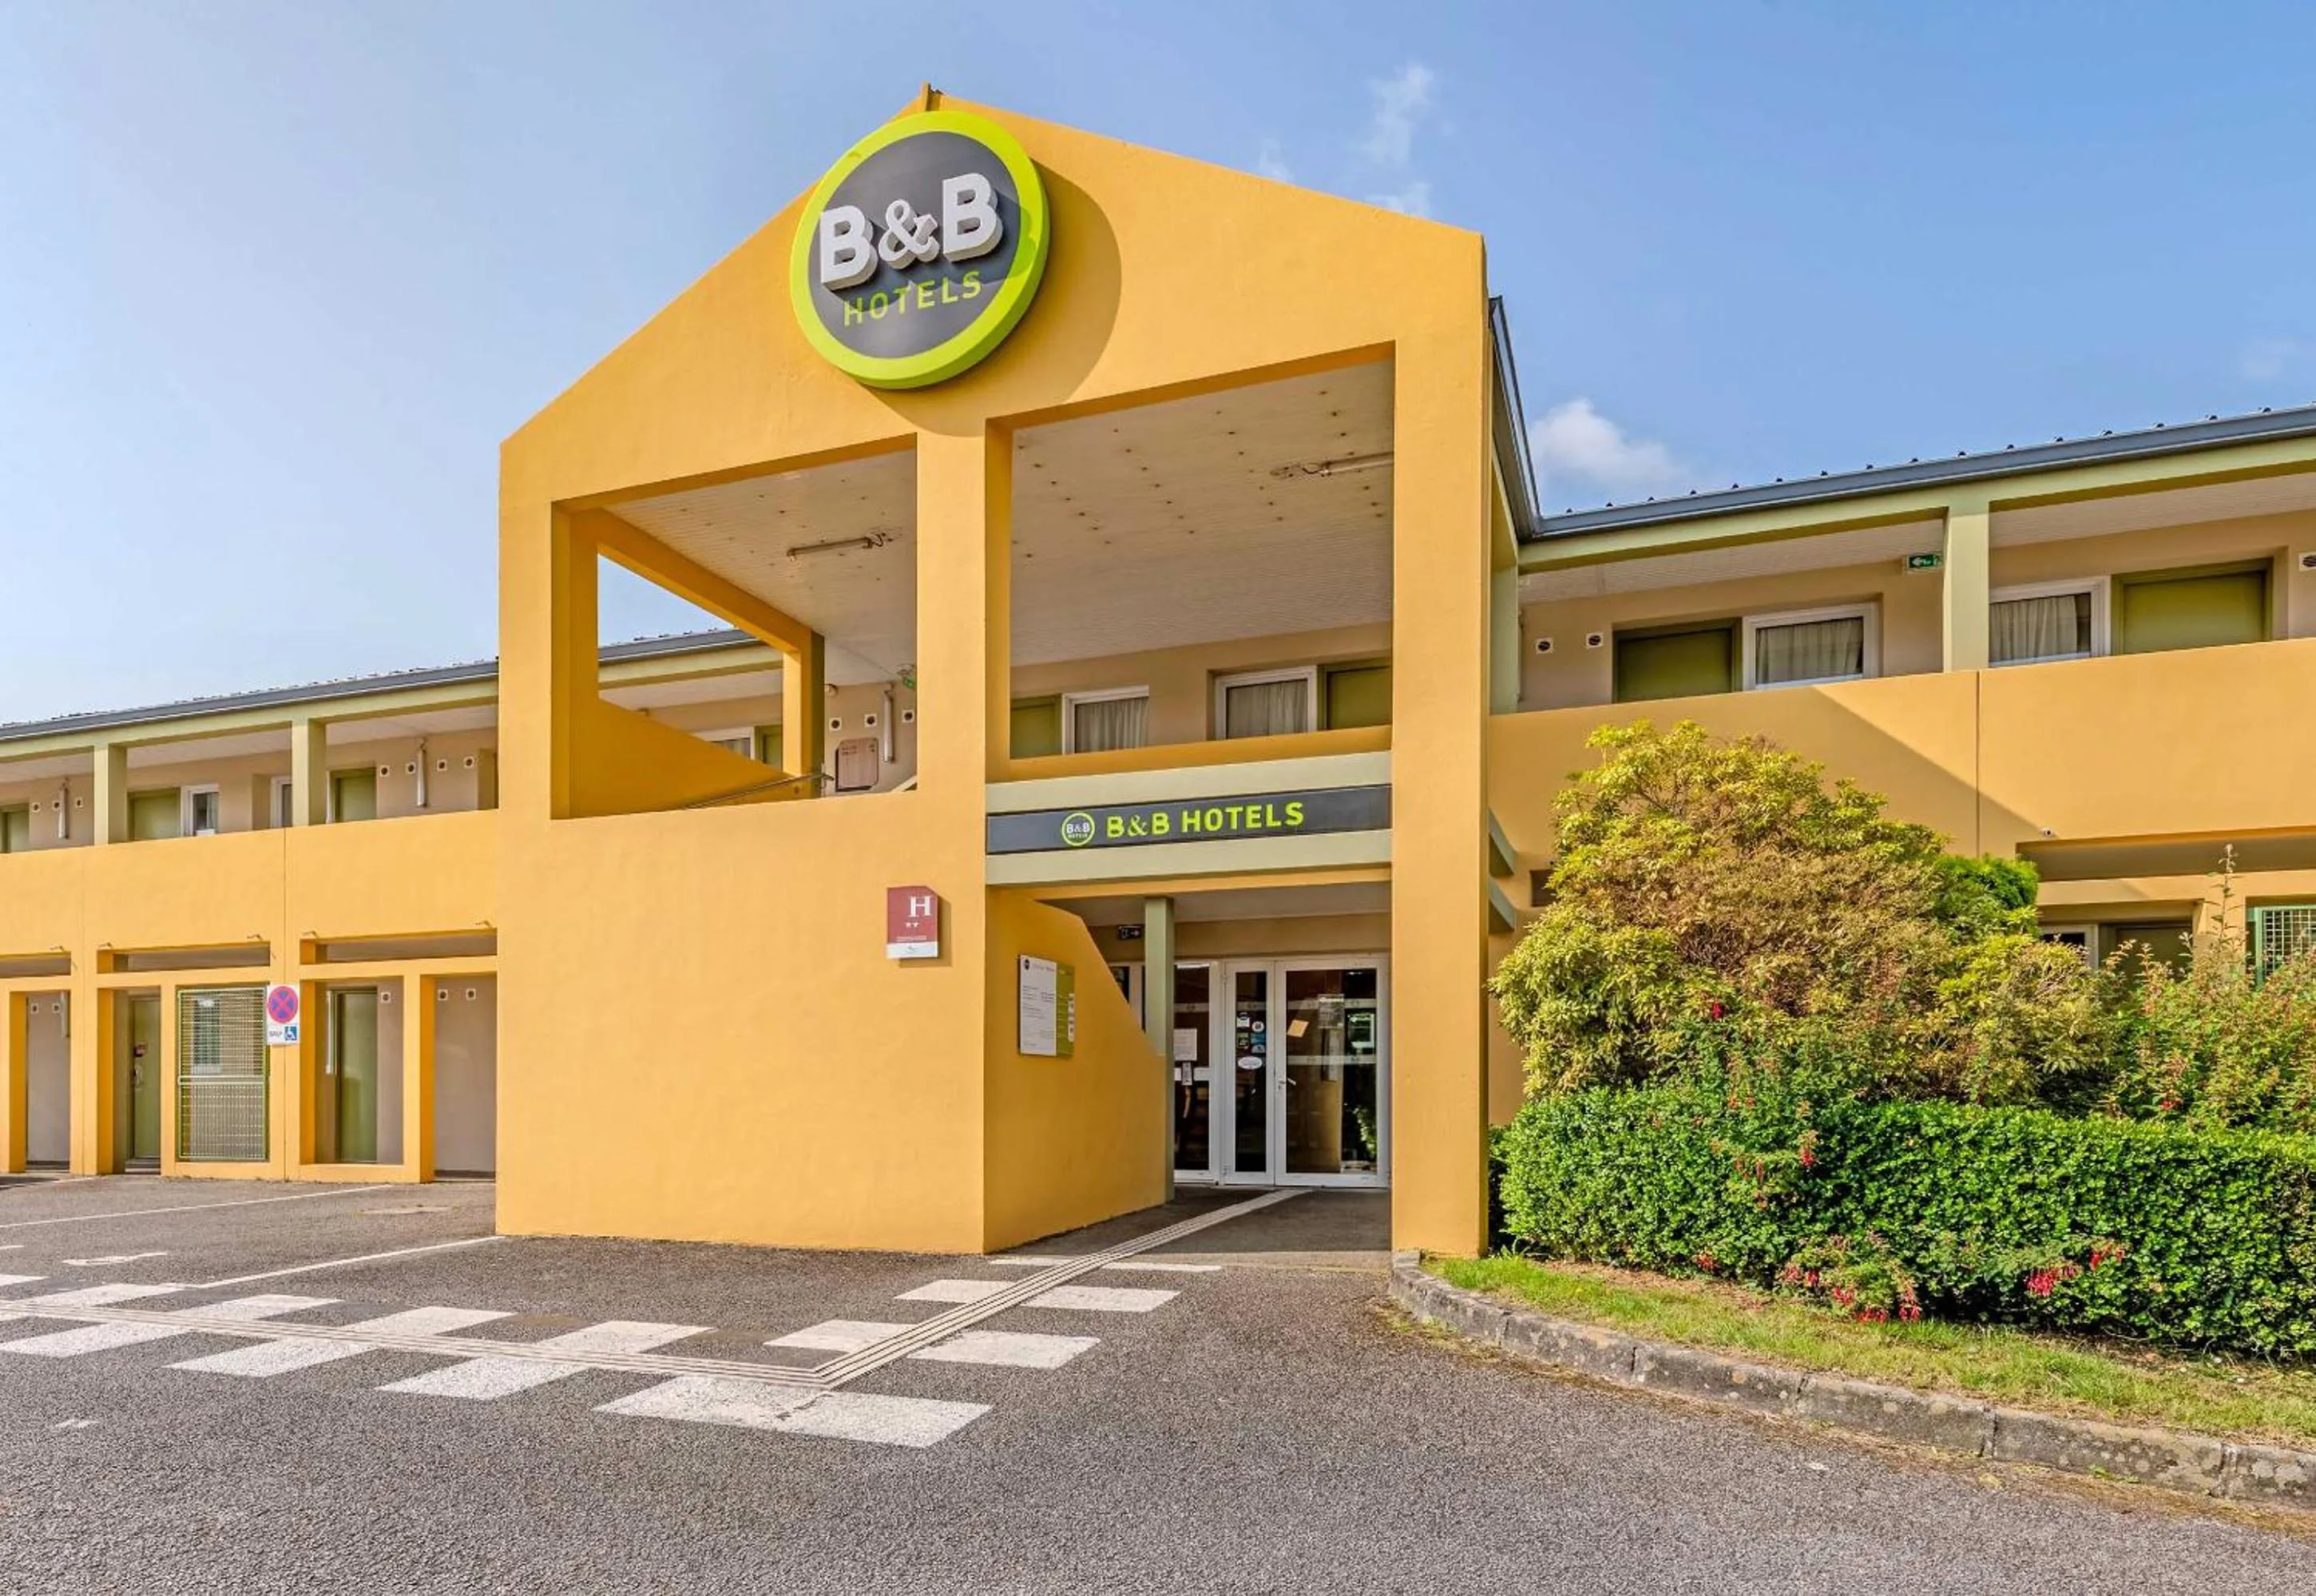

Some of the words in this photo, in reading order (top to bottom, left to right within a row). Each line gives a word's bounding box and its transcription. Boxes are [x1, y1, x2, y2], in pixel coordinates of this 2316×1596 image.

[820, 173, 1002, 290] B&B
[844, 271, 982, 327] HOTELS
[1066, 822, 1090, 834] B&B
[1107, 813, 1170, 838] B&B
[1182, 802, 1303, 833] HOTELS
[908, 896, 933, 917] H
